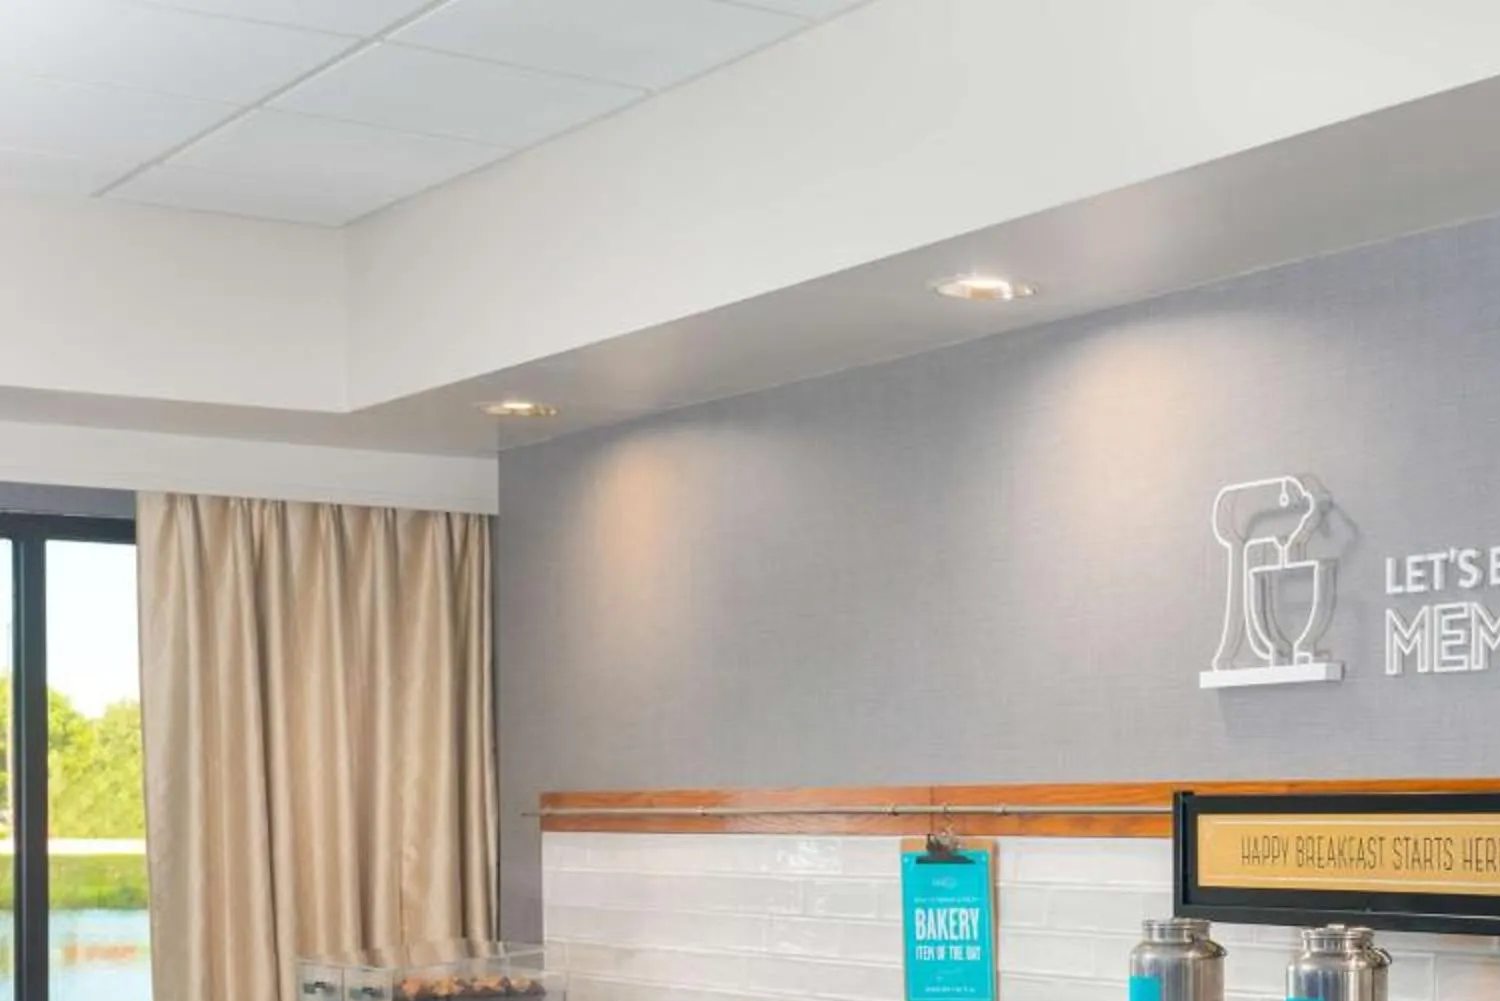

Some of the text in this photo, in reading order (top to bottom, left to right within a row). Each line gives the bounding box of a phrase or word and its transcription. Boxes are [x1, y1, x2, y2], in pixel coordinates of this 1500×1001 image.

[1385, 547, 1481, 594] LET'S
[1240, 834, 1290, 866] HAPPY
[1294, 835, 1387, 870] BREAKFAST
[1392, 836, 1454, 872] STARTS
[914, 907, 980, 941] BAKERY
